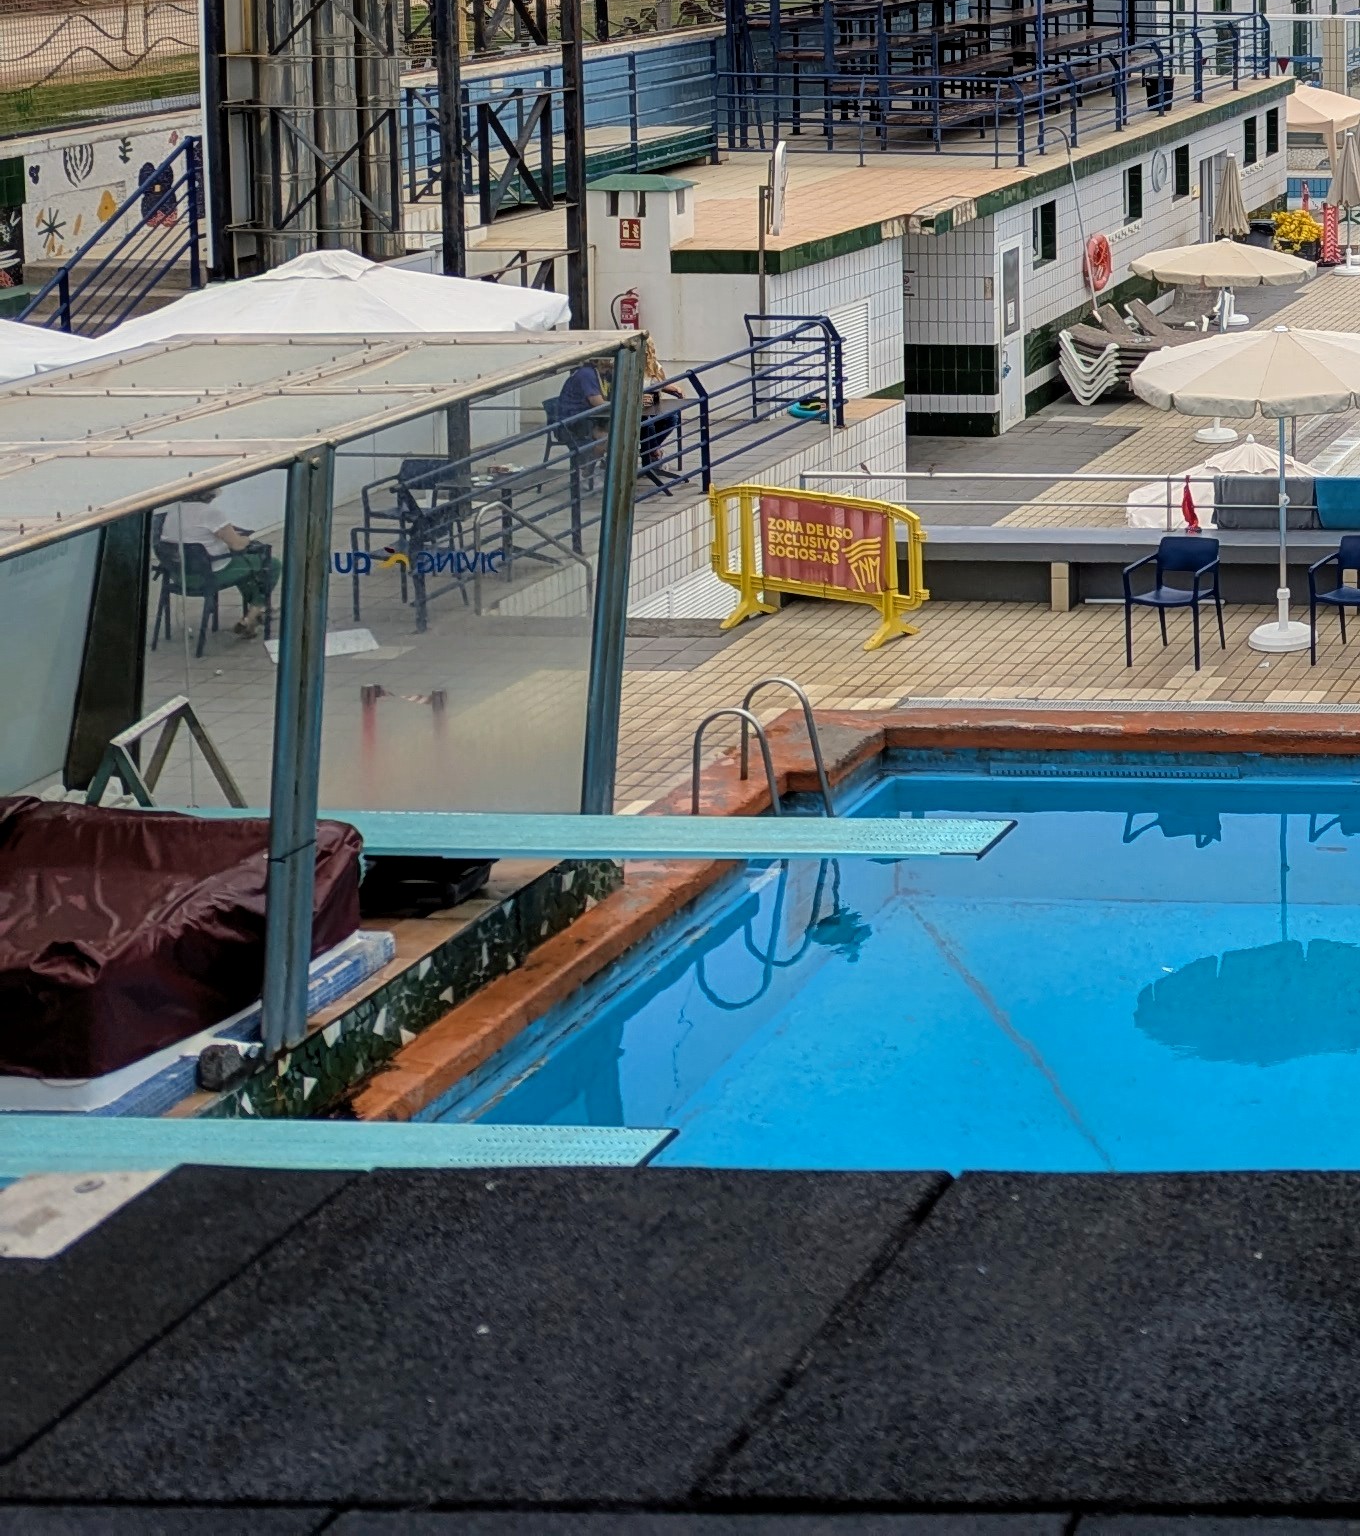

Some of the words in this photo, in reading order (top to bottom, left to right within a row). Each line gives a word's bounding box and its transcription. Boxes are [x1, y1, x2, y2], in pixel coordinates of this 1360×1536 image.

[767, 517, 803, 534] ZONA
[806, 524, 824, 537] DE
[826, 526, 854, 540] USO
[768, 530, 840, 552] EXCLUSIVO
[768, 546, 840, 565] SOCIOS-AS
